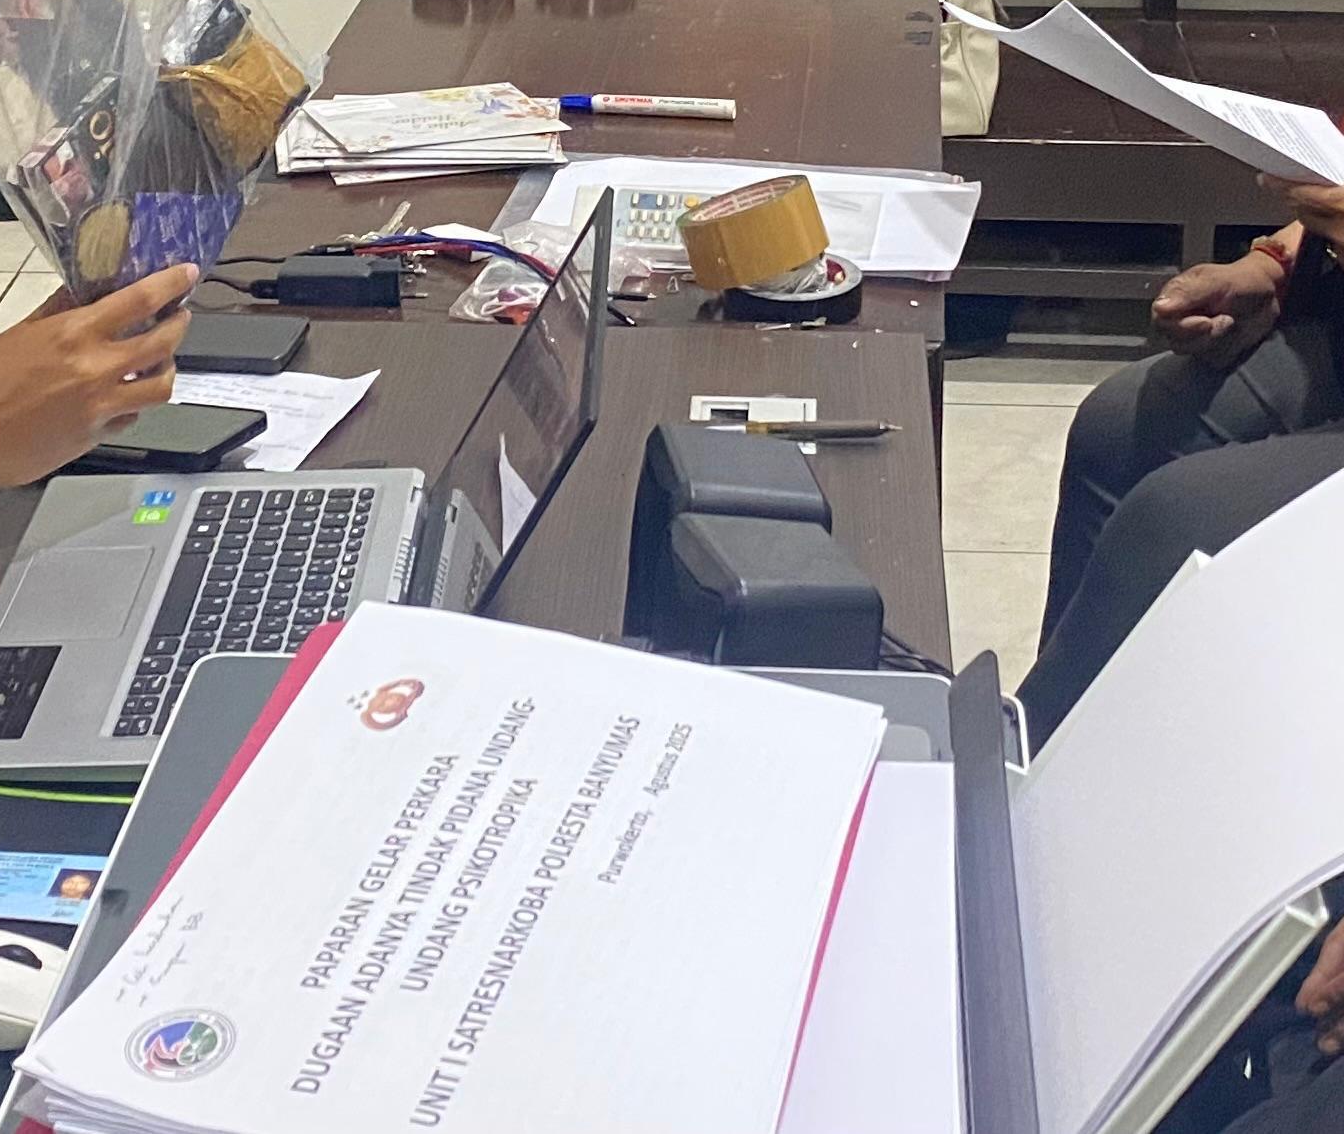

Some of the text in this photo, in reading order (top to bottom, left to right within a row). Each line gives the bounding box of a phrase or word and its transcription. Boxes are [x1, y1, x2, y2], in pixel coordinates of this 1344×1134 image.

[290, 696, 536, 1095] DUGAAN ADANYA TINDAK PIDANA UNDANG-
[300, 753, 460, 990] PAPARAN GELAR PERKARA
[399, 776, 539, 993] UNDANG PSIKOTROPIKA
[409, 1068, 461, 1128] UNIT
[447, 884, 554, 1055] SATRESNARKOBA
[533, 801, 598, 882] POLRESTA
[578, 713, 641, 801] BANYUMAS
[598, 721, 693, 885] Purwokerto, Agustus 2025
